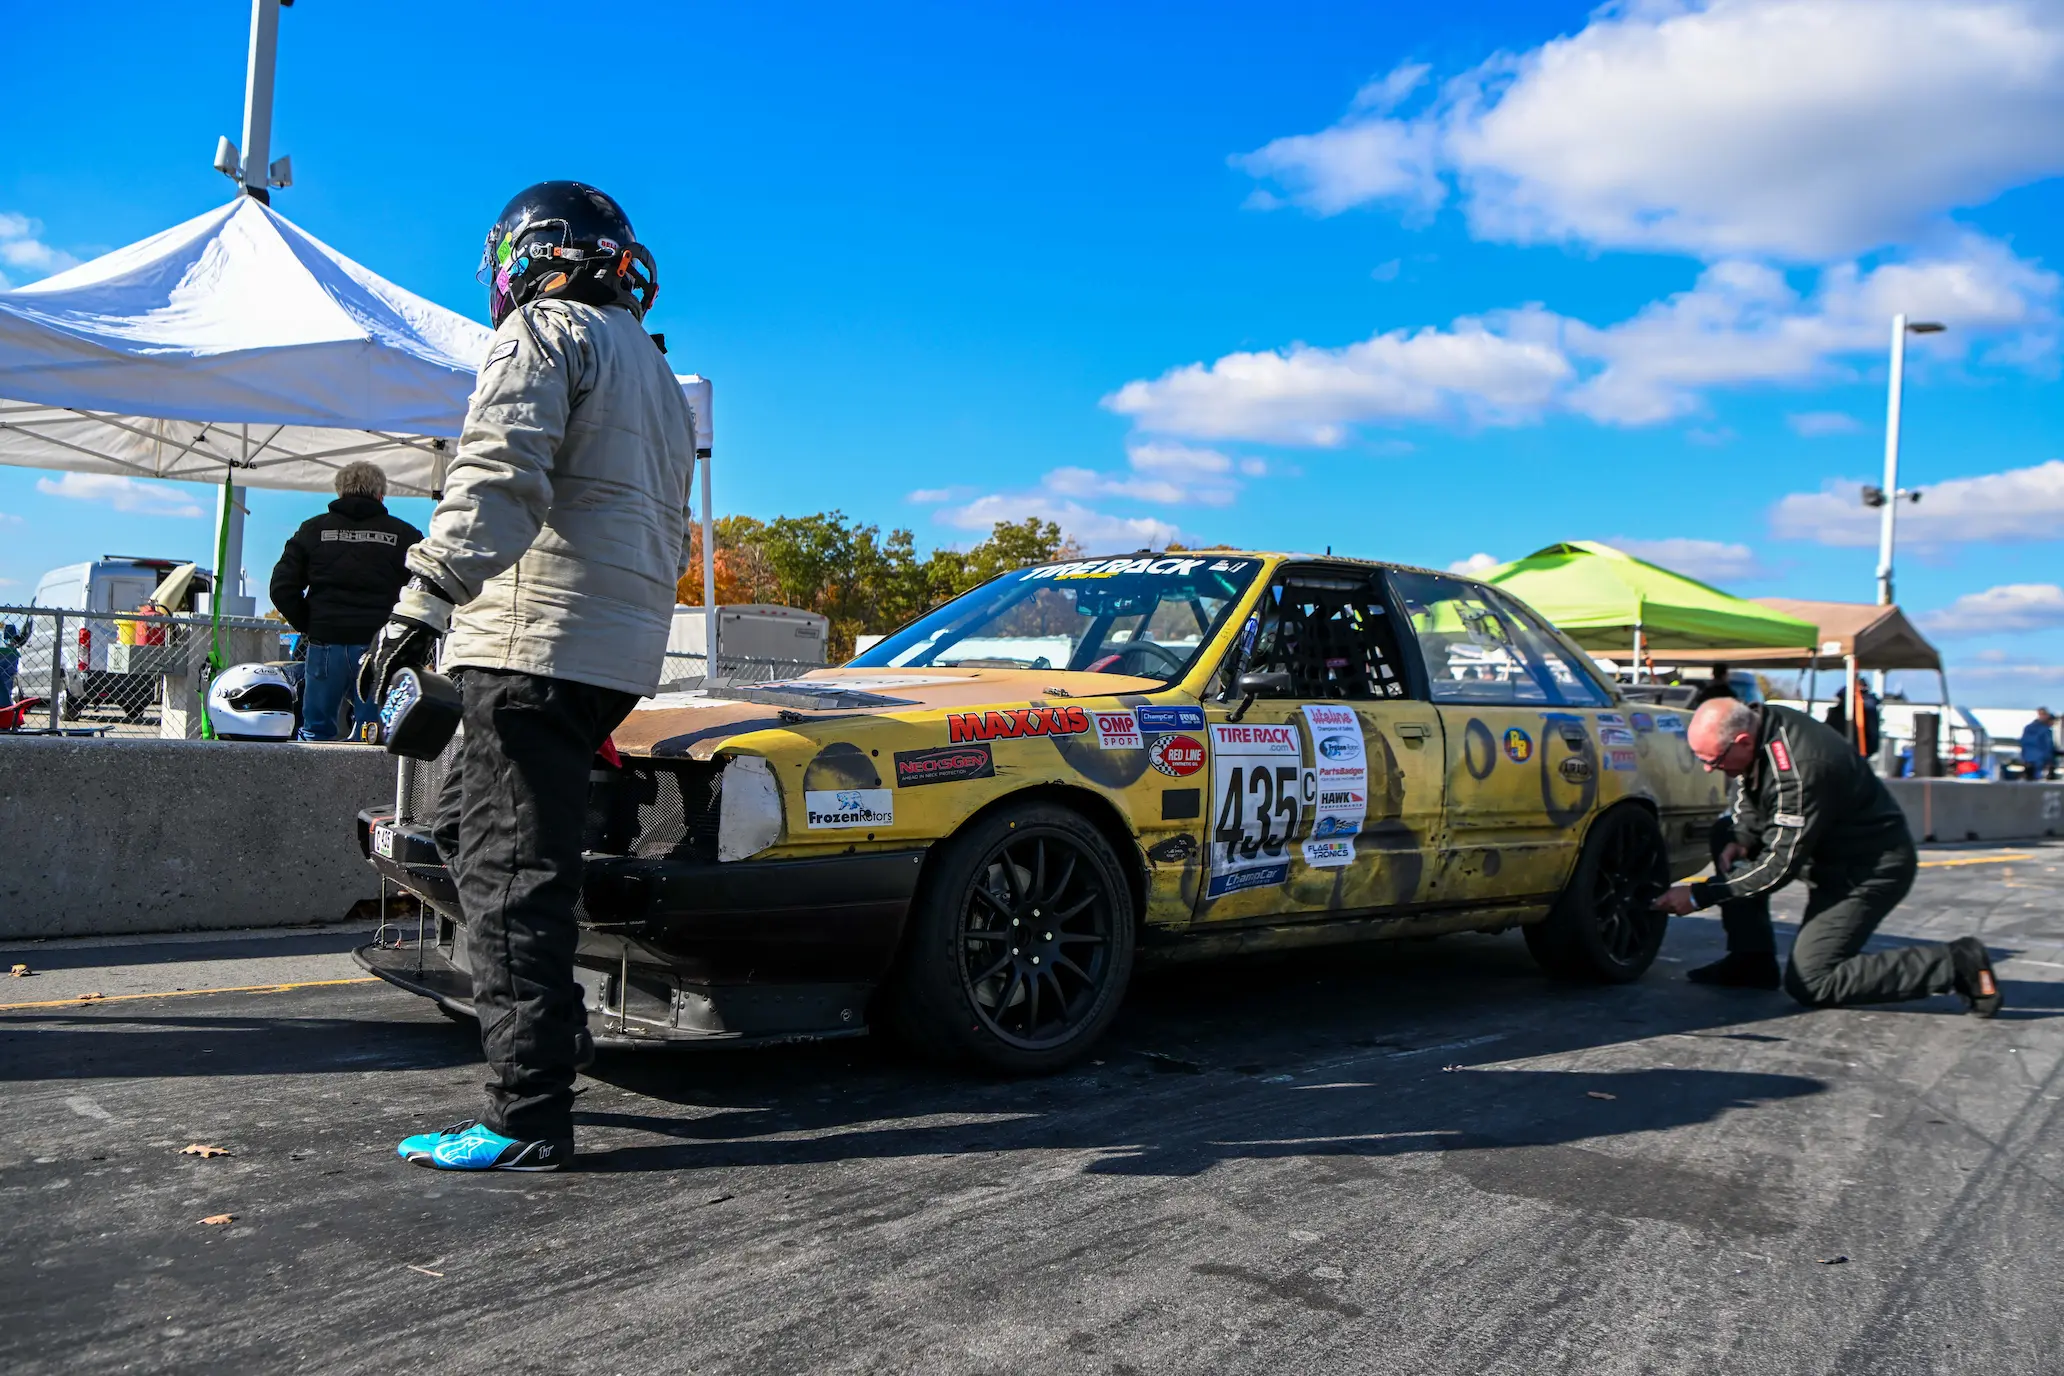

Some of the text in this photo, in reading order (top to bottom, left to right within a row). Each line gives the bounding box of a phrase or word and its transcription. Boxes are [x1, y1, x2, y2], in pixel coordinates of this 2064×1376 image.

[339, 532, 394, 543] SHELBY
[1143, 713, 1174, 721] ChampCar
[948, 707, 1090, 742] MAXXIS
[1099, 716, 1134, 734] OMP
[1104, 737, 1139, 746] SPORT
[1217, 727, 1295, 751] TIRE RACK
[1168, 748, 1184, 761] RED
[1185, 748, 1202, 761] LINE
[938, 769, 967, 777] PROTECTION
[1322, 792, 1350, 804] HAWK
[1216, 766, 1316, 863] 435 C
[1308, 844, 1329, 853] FLAG
[1313, 849, 1348, 859] TRONICS
[1226, 869, 1278, 887] ChampCar
